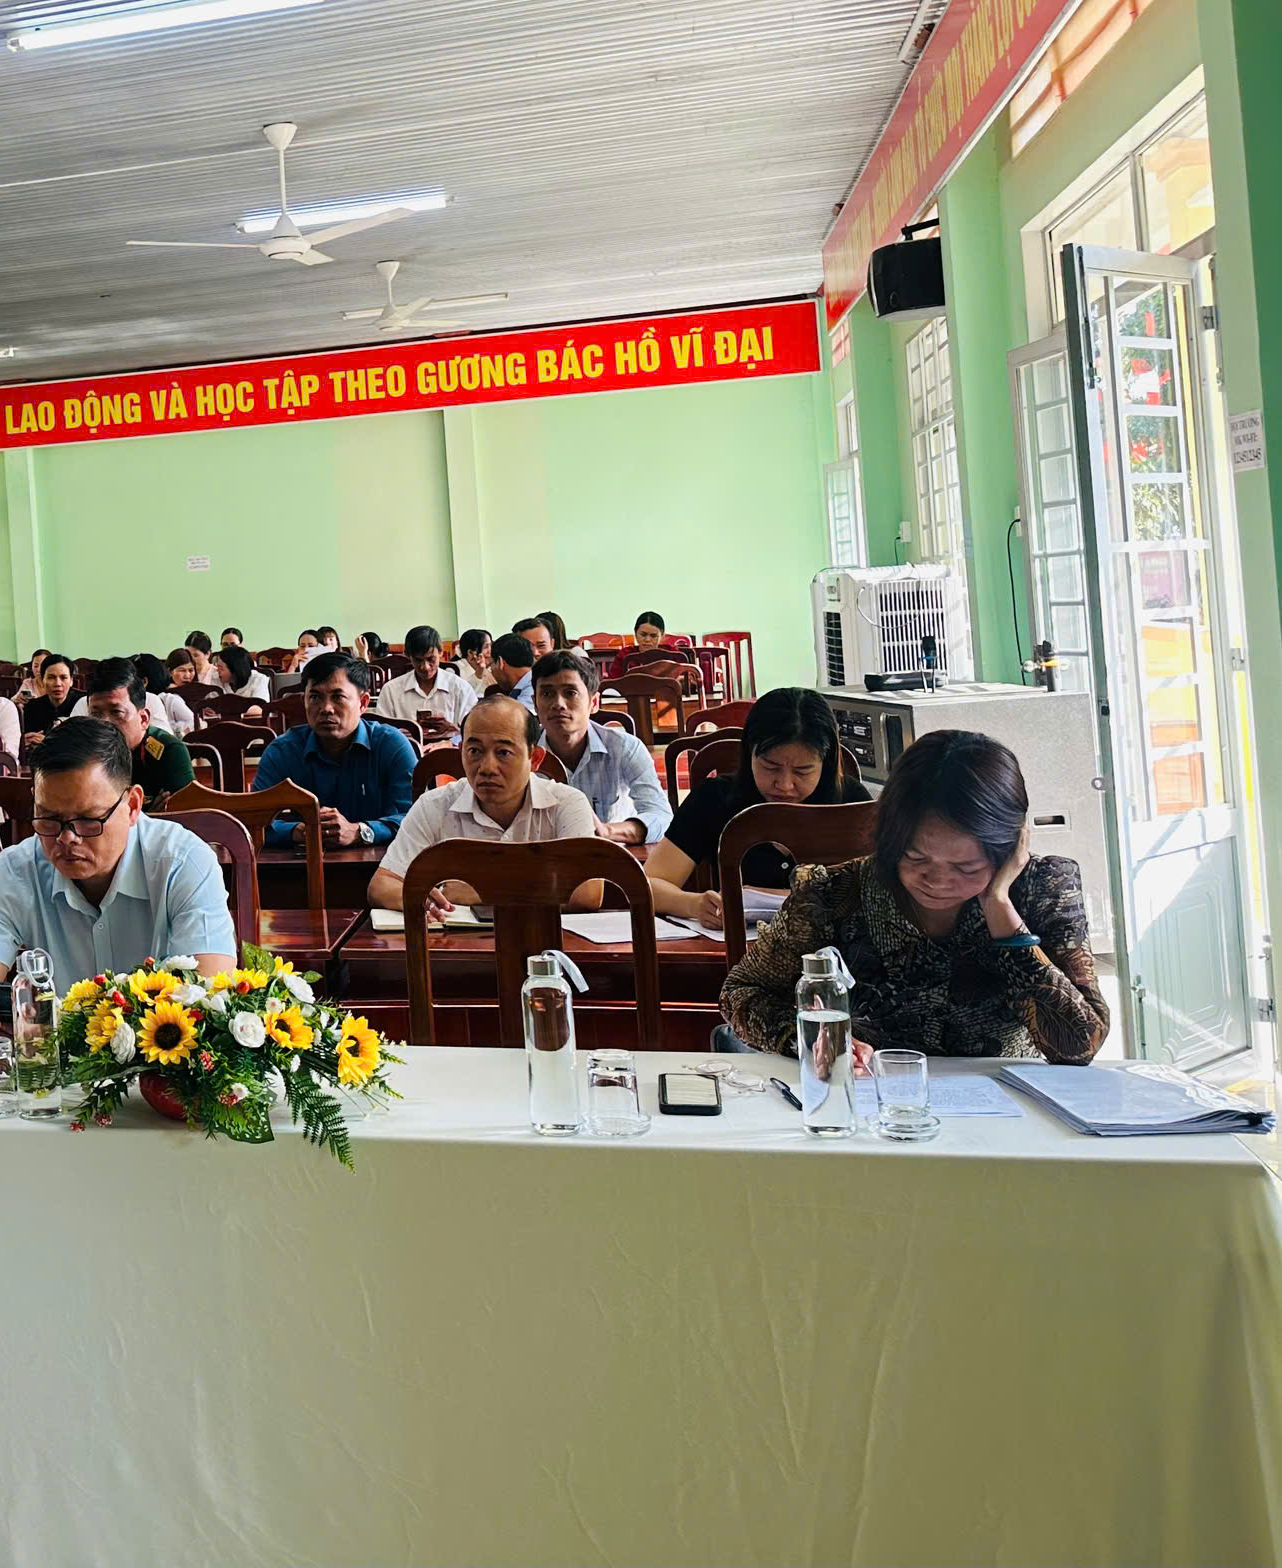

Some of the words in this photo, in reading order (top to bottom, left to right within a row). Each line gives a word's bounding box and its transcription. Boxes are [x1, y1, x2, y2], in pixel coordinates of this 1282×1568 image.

[6, 402, 54, 434] LAO
[64, 392, 141, 432] ĐỘNG
[150, 382, 188, 420] VÀ
[196, 382, 254, 420] HỌC
[263, 370, 319, 414] TẬP
[329, 365, 406, 402] THEO
[417, 353, 526, 394] GƯƠNG
[537, 340, 604, 382] BÁC
[615, 328, 660, 374] HỒ
[670, 328, 703, 368] VĨ
[714, 327, 773, 369] ĐẠI
